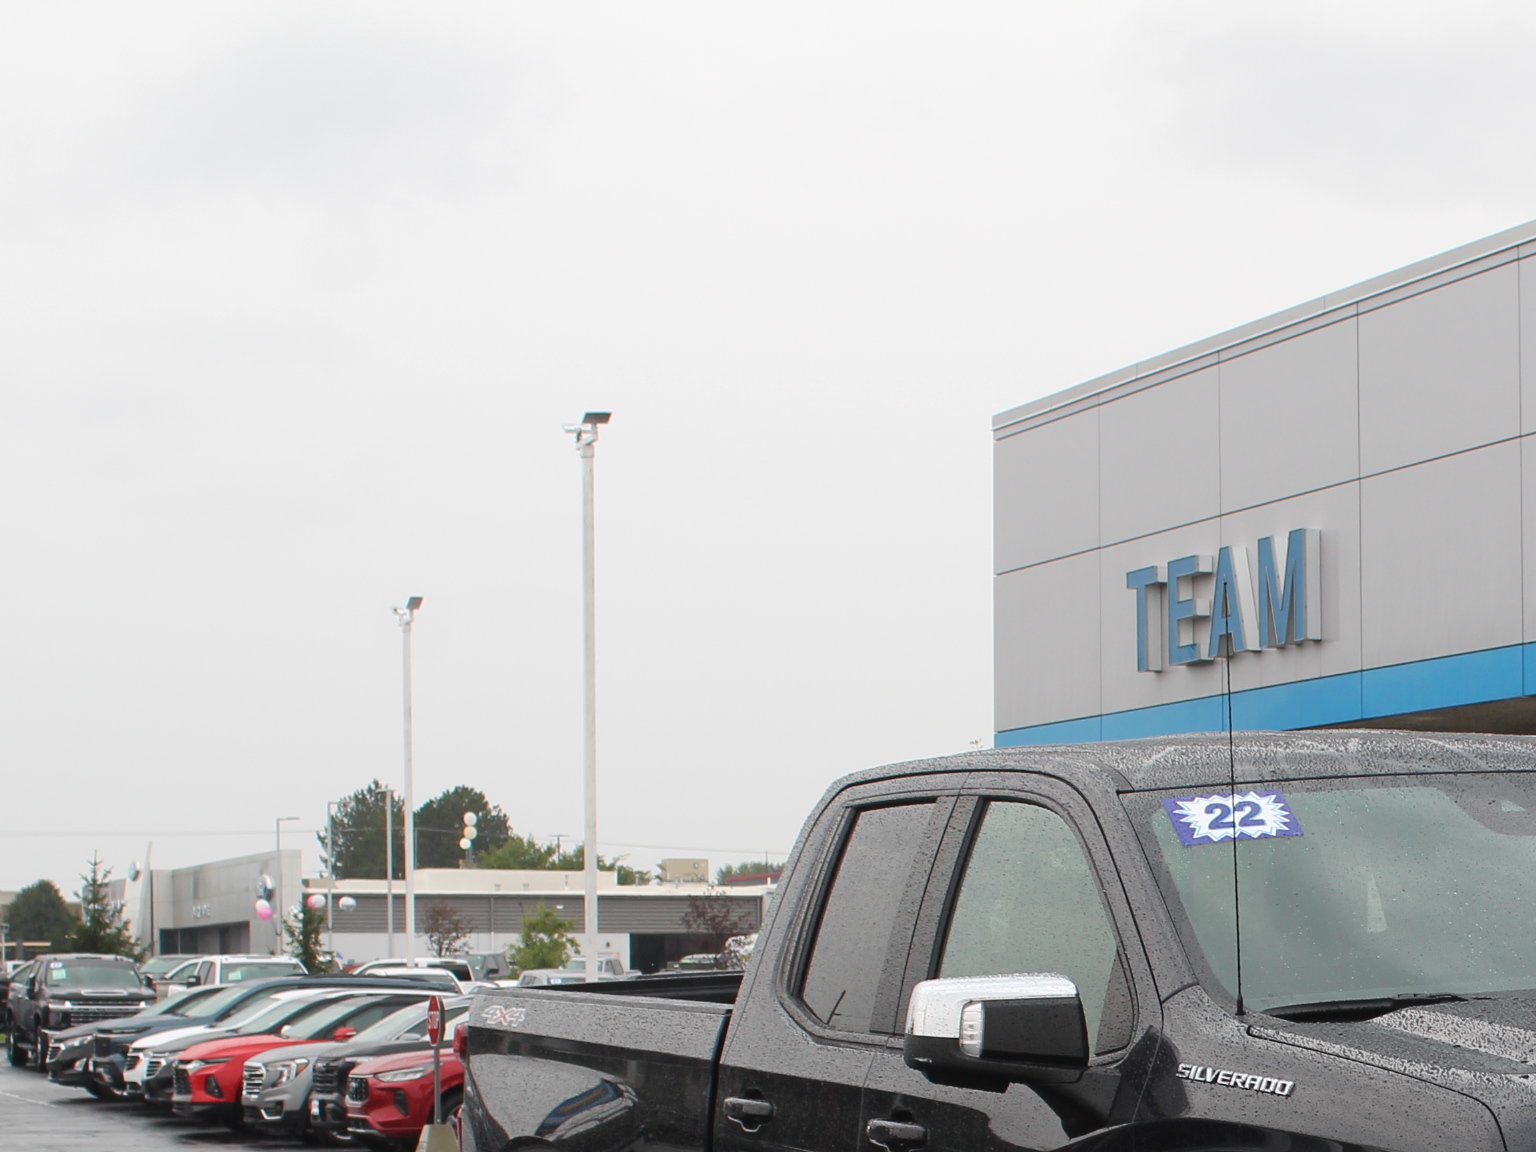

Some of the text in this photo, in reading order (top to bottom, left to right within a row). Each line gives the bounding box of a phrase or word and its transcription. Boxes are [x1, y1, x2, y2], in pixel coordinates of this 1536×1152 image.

[1126, 527, 1321, 672] TEAM
[1204, 800, 1267, 830] 22
[1176, 1062, 1295, 1097] SILVERADO
